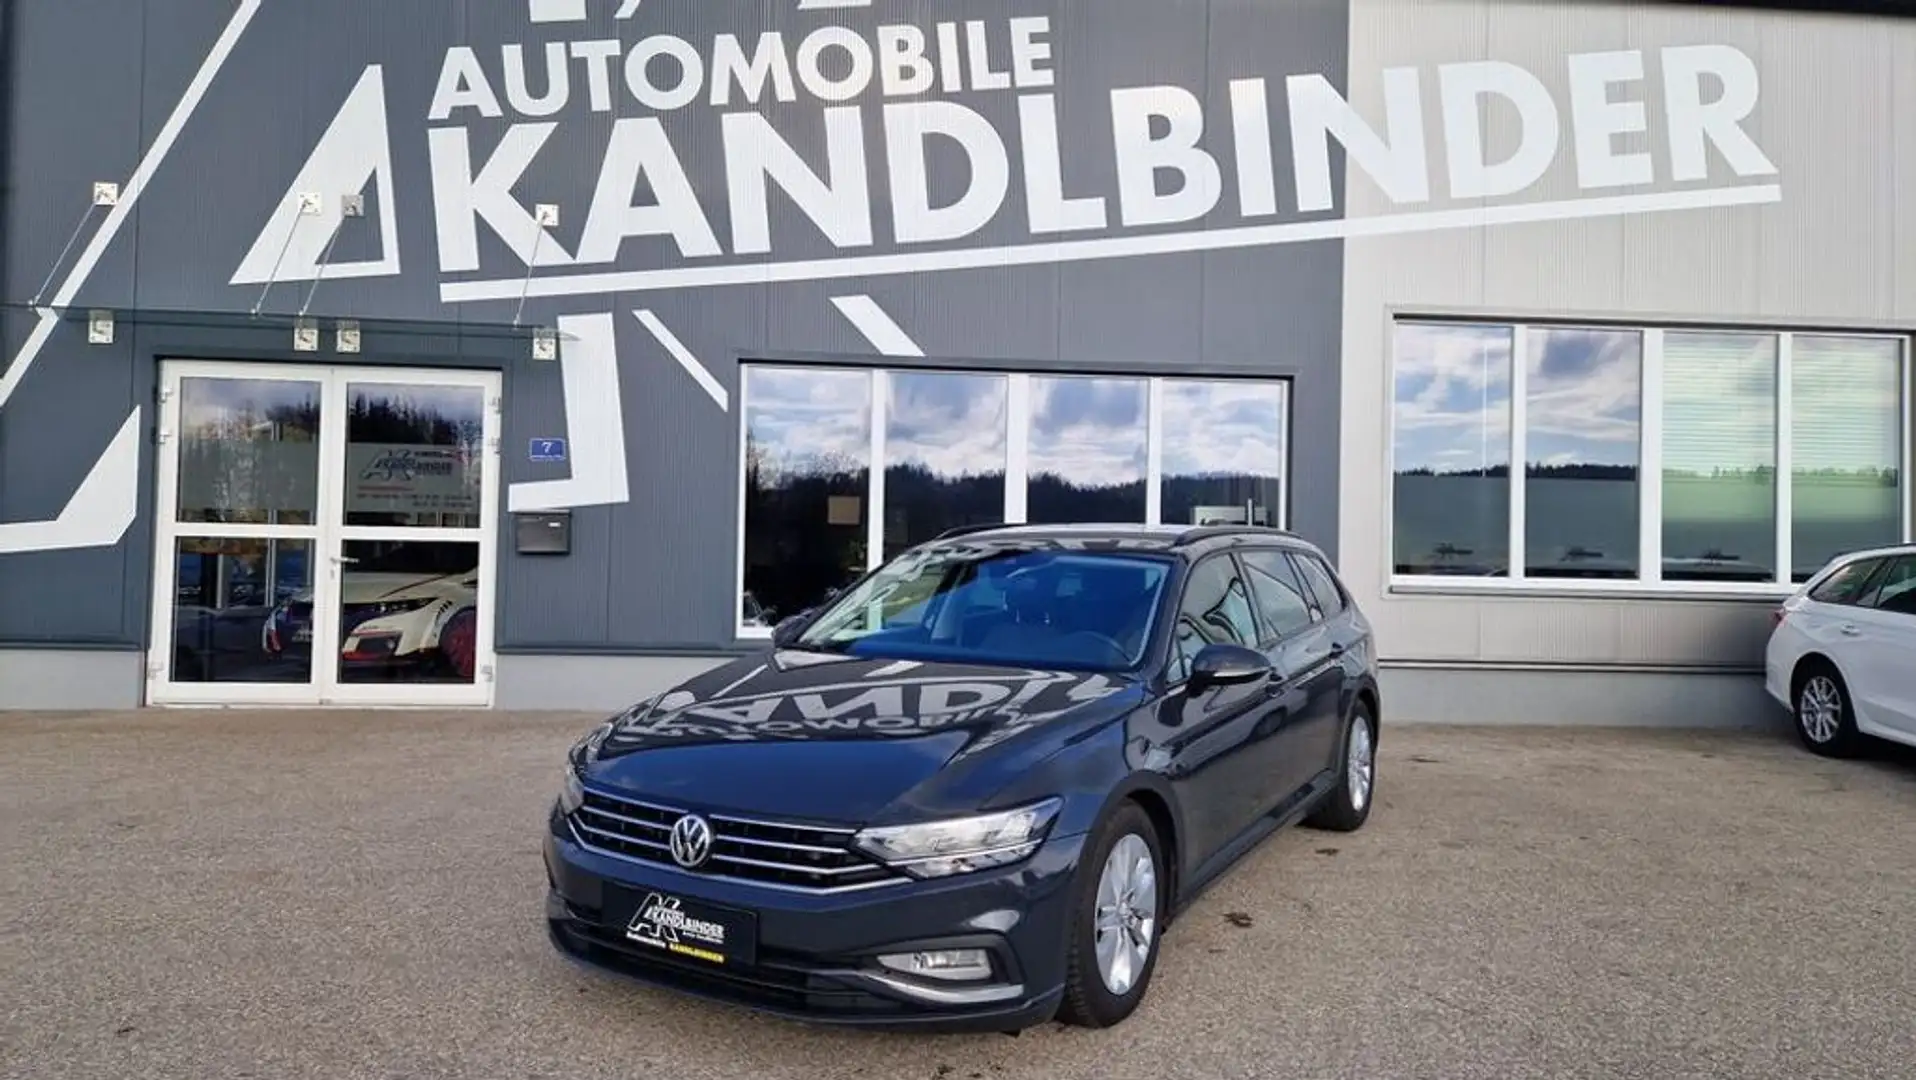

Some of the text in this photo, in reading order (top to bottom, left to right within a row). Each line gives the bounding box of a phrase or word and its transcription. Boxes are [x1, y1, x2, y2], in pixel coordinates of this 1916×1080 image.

[427, 16, 1055, 119] AUTOMOBILE
[427, 44, 1779, 271] KANDLBINDER
[541, 441, 553, 454] 7
